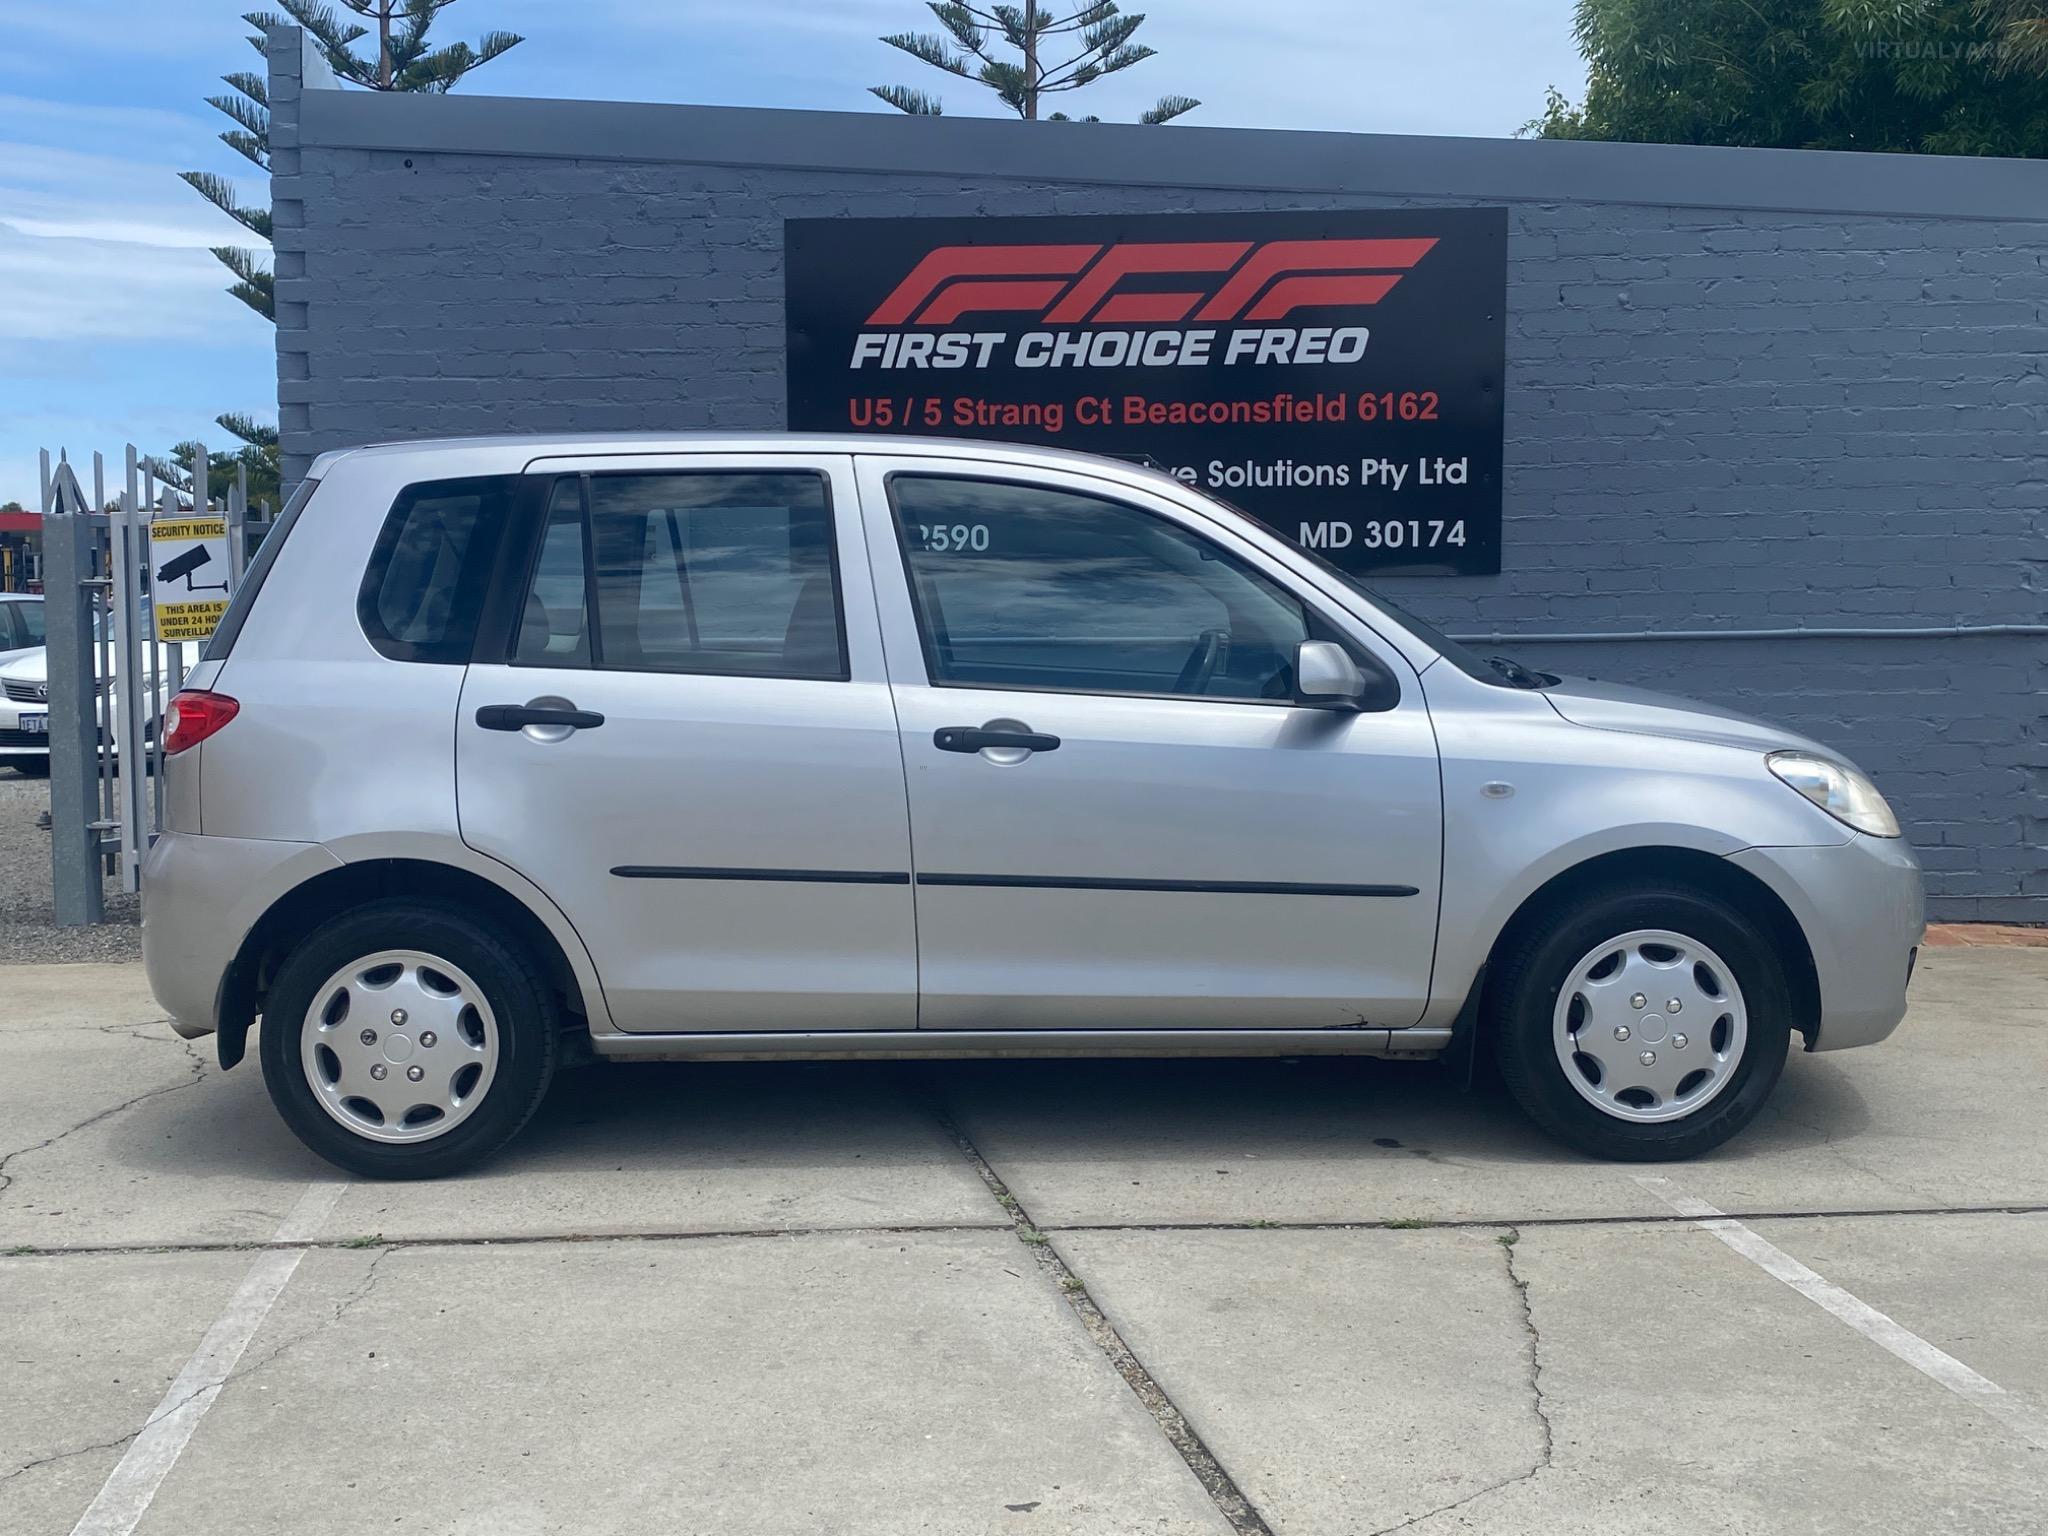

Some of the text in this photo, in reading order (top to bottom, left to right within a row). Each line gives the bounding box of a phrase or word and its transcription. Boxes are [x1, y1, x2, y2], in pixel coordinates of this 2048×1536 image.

[850, 327, 1370, 369] FIRST CHOICE FREO
[850, 391, 1439, 432] U5 / 5 Strang Ct Beaconsfield 6162
[1207, 459, 1350, 488] Solutions
[1361, 458, 1409, 491] Pty
[1419, 456, 1468, 485] Ltd
[152, 523, 225, 538] SECURITY NOTICE
[1299, 519, 1466, 549] MD 30174
[160, 616, 189, 626] UNDER
[191, 616, 203, 625] 24
[165, 603, 223, 614] THIS AREA IS
